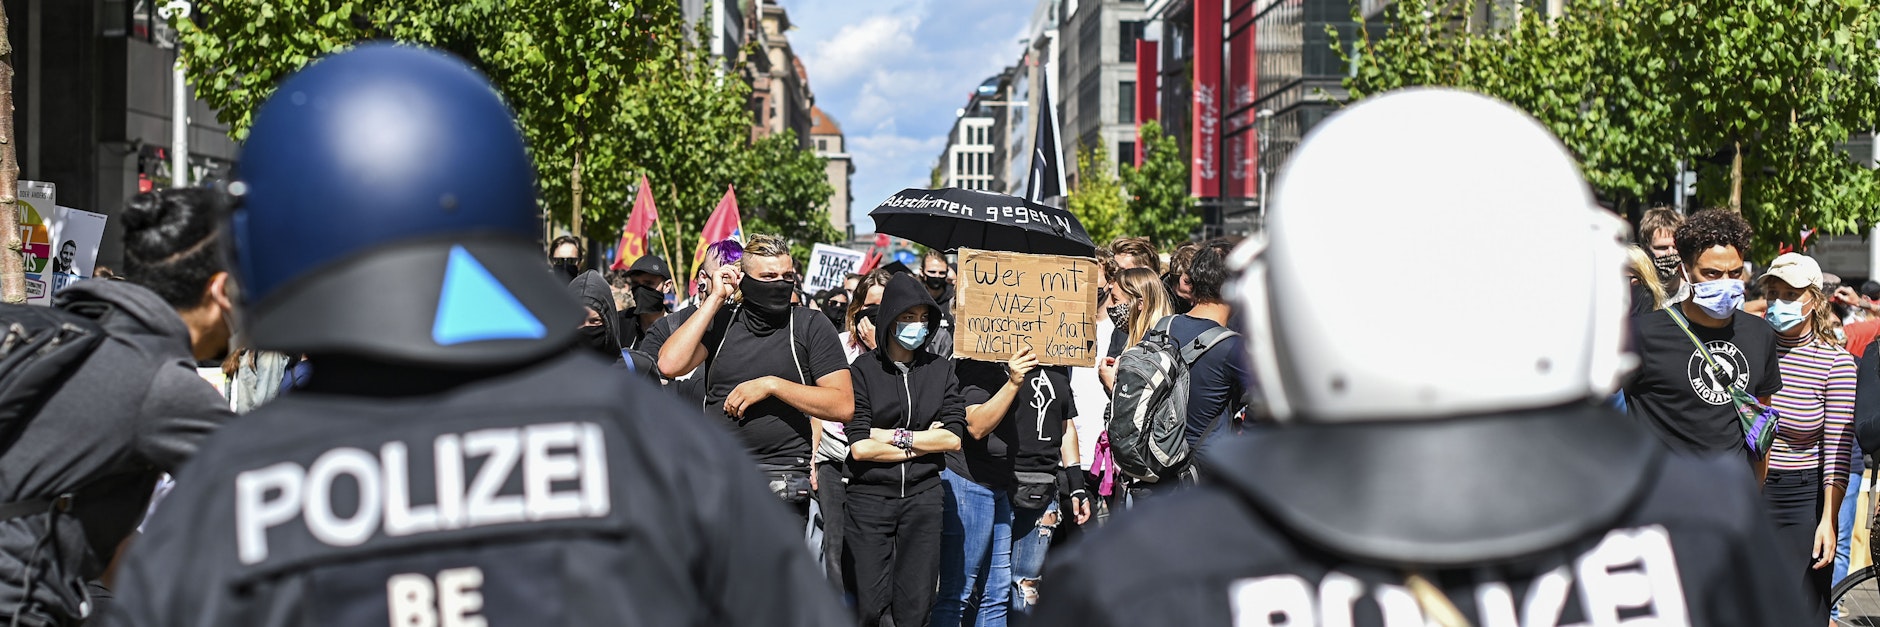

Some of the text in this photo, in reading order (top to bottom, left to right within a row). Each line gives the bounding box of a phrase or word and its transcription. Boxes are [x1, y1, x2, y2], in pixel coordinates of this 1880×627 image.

[882, 194, 973, 216] Abschirmen
[986, 206, 1052, 226] gegen
[820, 255, 855, 271] BLACK
[820, 266, 848, 279] LIVES
[974, 261, 1084, 292] Wer mit
[990, 292, 1055, 316] NAZIS
[968, 312, 1092, 338] marschiert hat
[976, 334, 1034, 354] NICHTS
[235, 422, 611, 565] POLIZEI
[387, 567, 488, 627] BE
